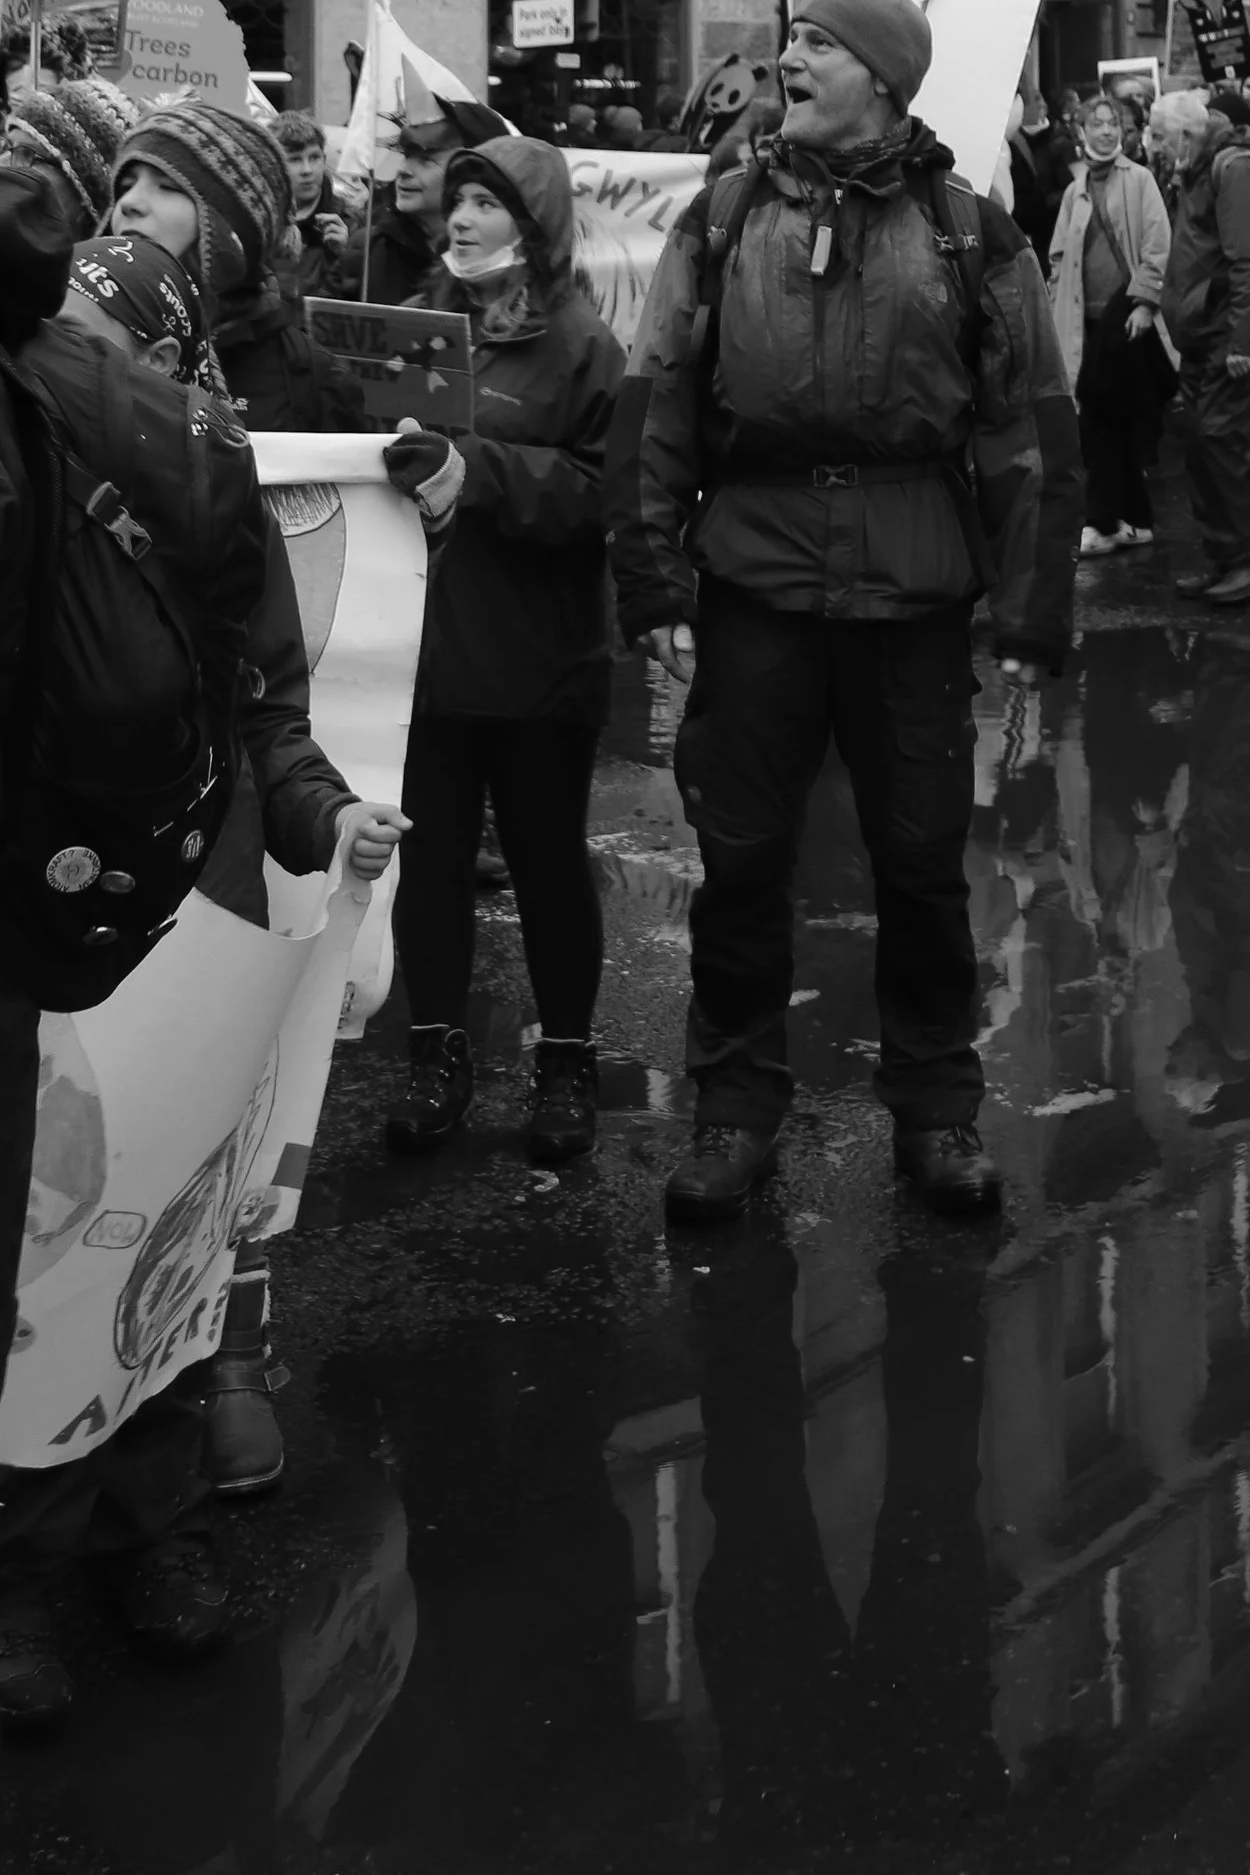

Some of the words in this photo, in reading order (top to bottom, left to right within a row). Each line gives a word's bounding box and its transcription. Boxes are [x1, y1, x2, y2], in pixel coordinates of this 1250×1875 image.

[126, 29, 192, 58] Trees
[132, 62, 219, 88] carbon
[311, 310, 387, 354] SAVE
